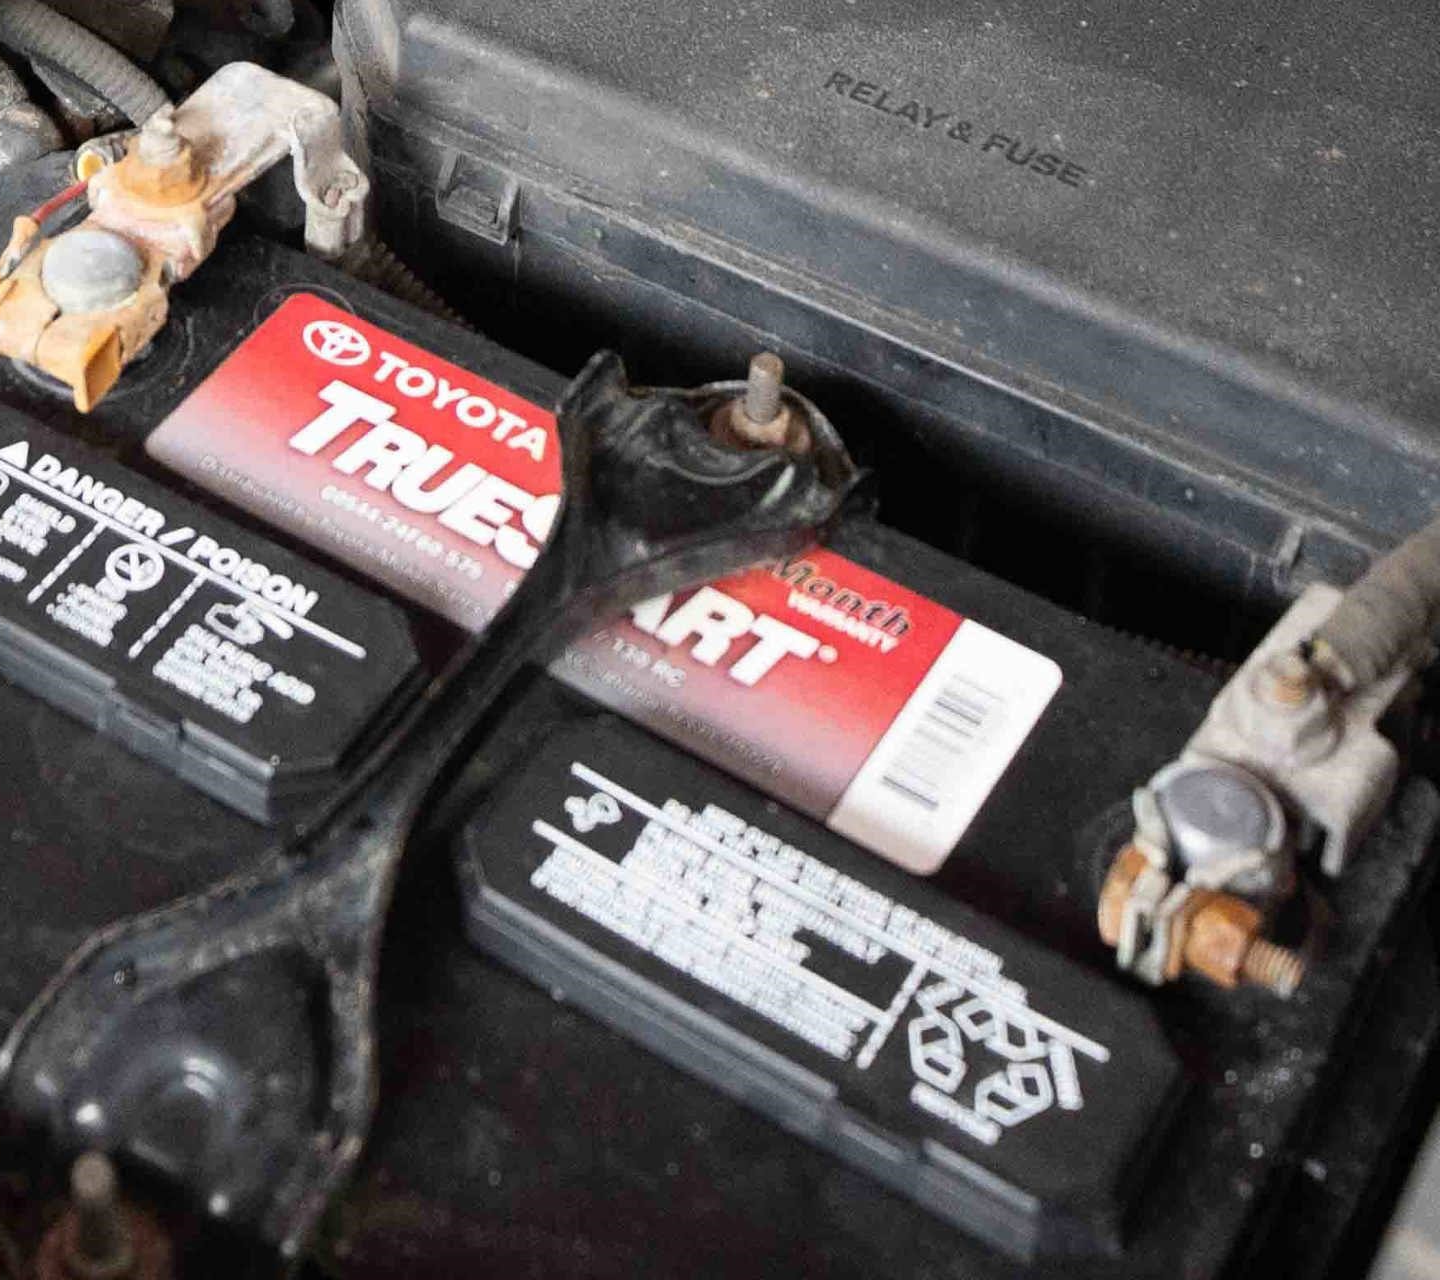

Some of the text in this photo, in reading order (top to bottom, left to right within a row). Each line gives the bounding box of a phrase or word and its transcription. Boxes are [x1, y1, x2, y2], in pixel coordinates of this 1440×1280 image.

[824, 71, 1088, 188] RELAY & FUSE
[372, 351, 548, 462] TOYOTA
[28, 453, 166, 537] DANGER
[185, 533, 319, 617] POISON
